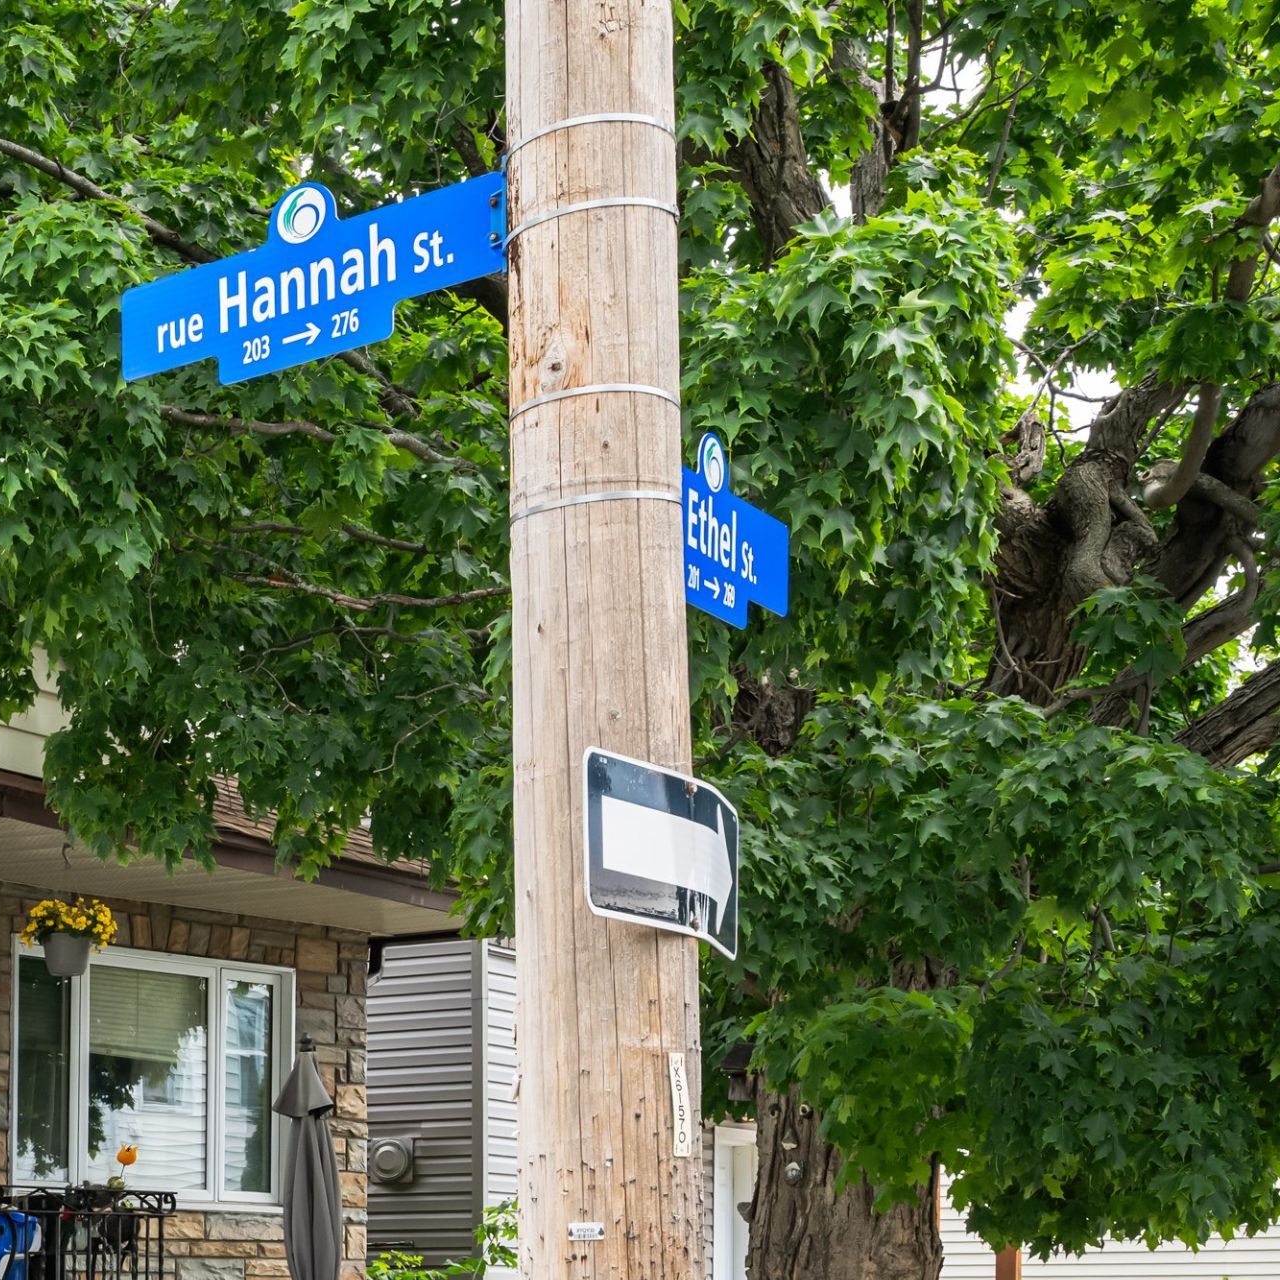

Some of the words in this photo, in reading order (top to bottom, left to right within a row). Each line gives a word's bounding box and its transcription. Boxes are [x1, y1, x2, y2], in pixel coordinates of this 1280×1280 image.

[156, 312, 204, 353] rue
[218, 222, 397, 334] Hannah
[413, 230, 455, 274] St.
[242, 335, 271, 365] 203
[330, 308, 360, 339] 276
[687, 488, 737, 573] Ethel
[740, 541, 758, 585] St.
[672, 1066, 687, 1145] X61570
